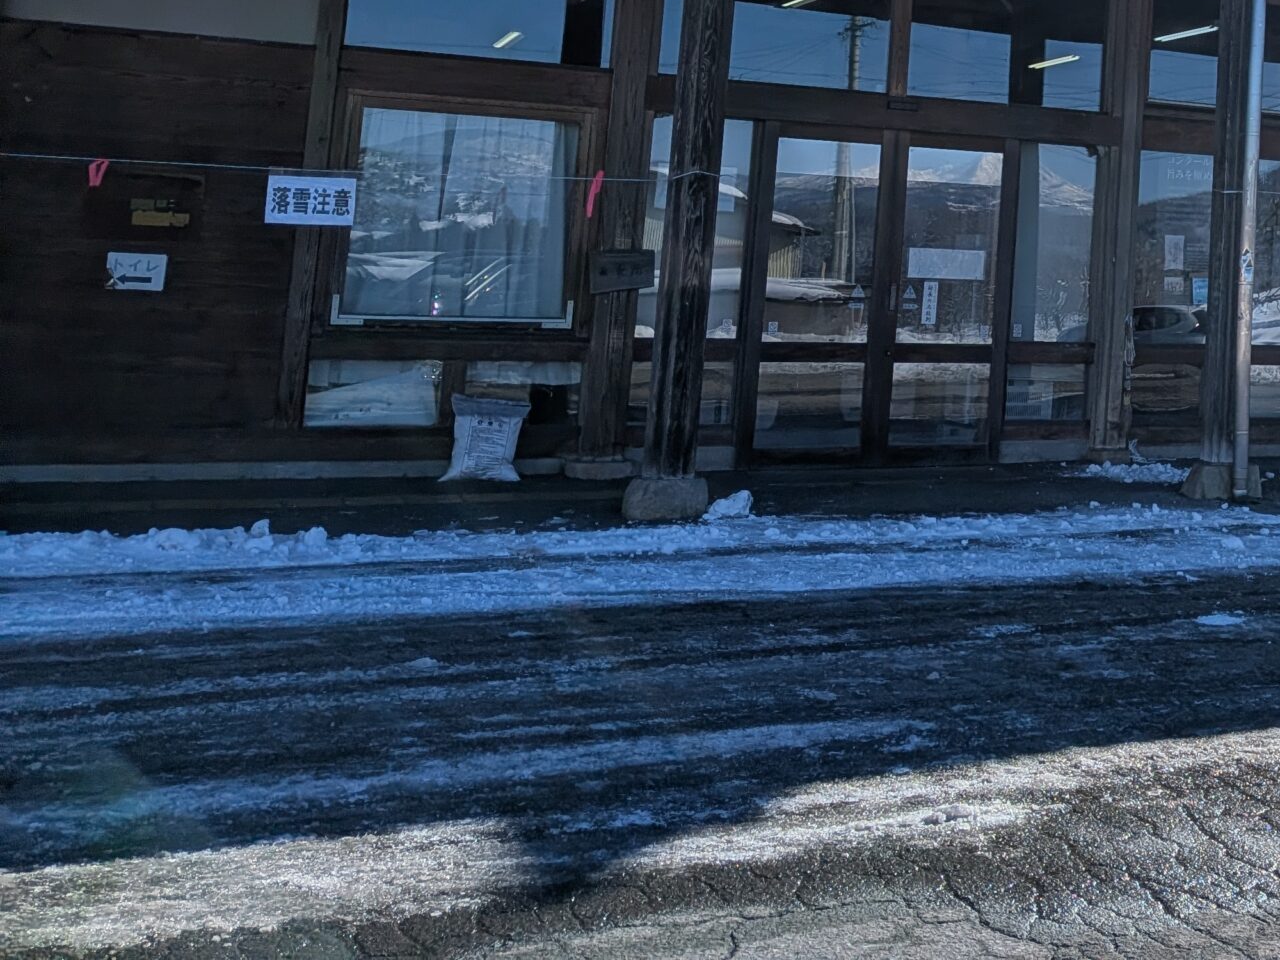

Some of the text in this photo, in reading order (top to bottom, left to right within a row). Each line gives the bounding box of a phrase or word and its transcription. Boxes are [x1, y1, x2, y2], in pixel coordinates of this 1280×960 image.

[270, 186, 353, 217] 落雪注意
[113, 257, 160, 272] トイレ
